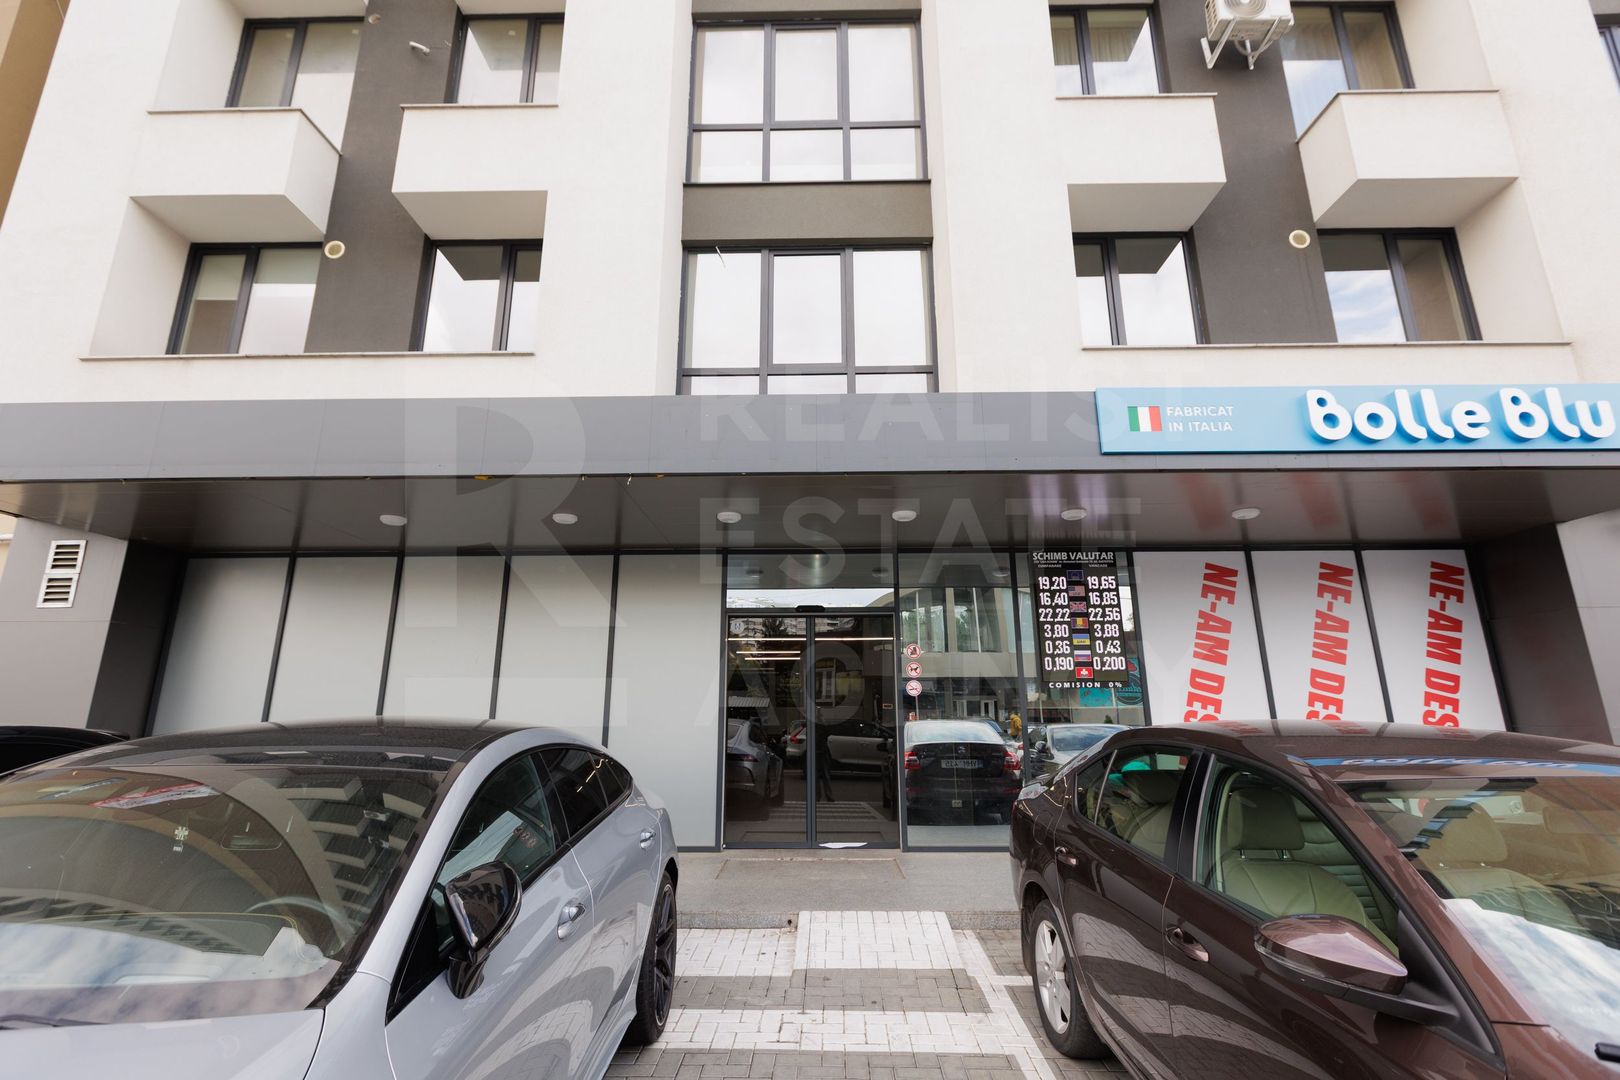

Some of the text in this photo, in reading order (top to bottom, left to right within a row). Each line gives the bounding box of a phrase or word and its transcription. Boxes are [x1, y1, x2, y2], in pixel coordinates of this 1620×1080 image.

[1166, 406, 1234, 416] FABRICAT
[1306, 387, 1616, 440] Bolle Blu
[1168, 422, 1233, 432] IN ITALIA
[1032, 552, 1114, 560] SCHIMB VALUTAR
[1038, 576, 1067, 590] 19,20
[1087, 576, 1116, 590] 19,65
[1039, 592, 1068, 606] 16,40
[1088, 592, 1118, 606] 16,85
[1039, 608, 1071, 622] 22,22
[1088, 608, 1120, 622] 22,56
[1192, 562, 1238, 666] NE-AM
[1312, 562, 1354, 666] NE-AM
[1425, 561, 1465, 666] NE-AM
[1044, 624, 1069, 638] 3,80
[1094, 624, 1119, 638] 3,88
[1045, 641, 1070, 654] 0,36
[1095, 640, 1120, 654] 0,43
[1044, 657, 1074, 671] 0,190
[1093, 656, 1126, 671] 0,200
